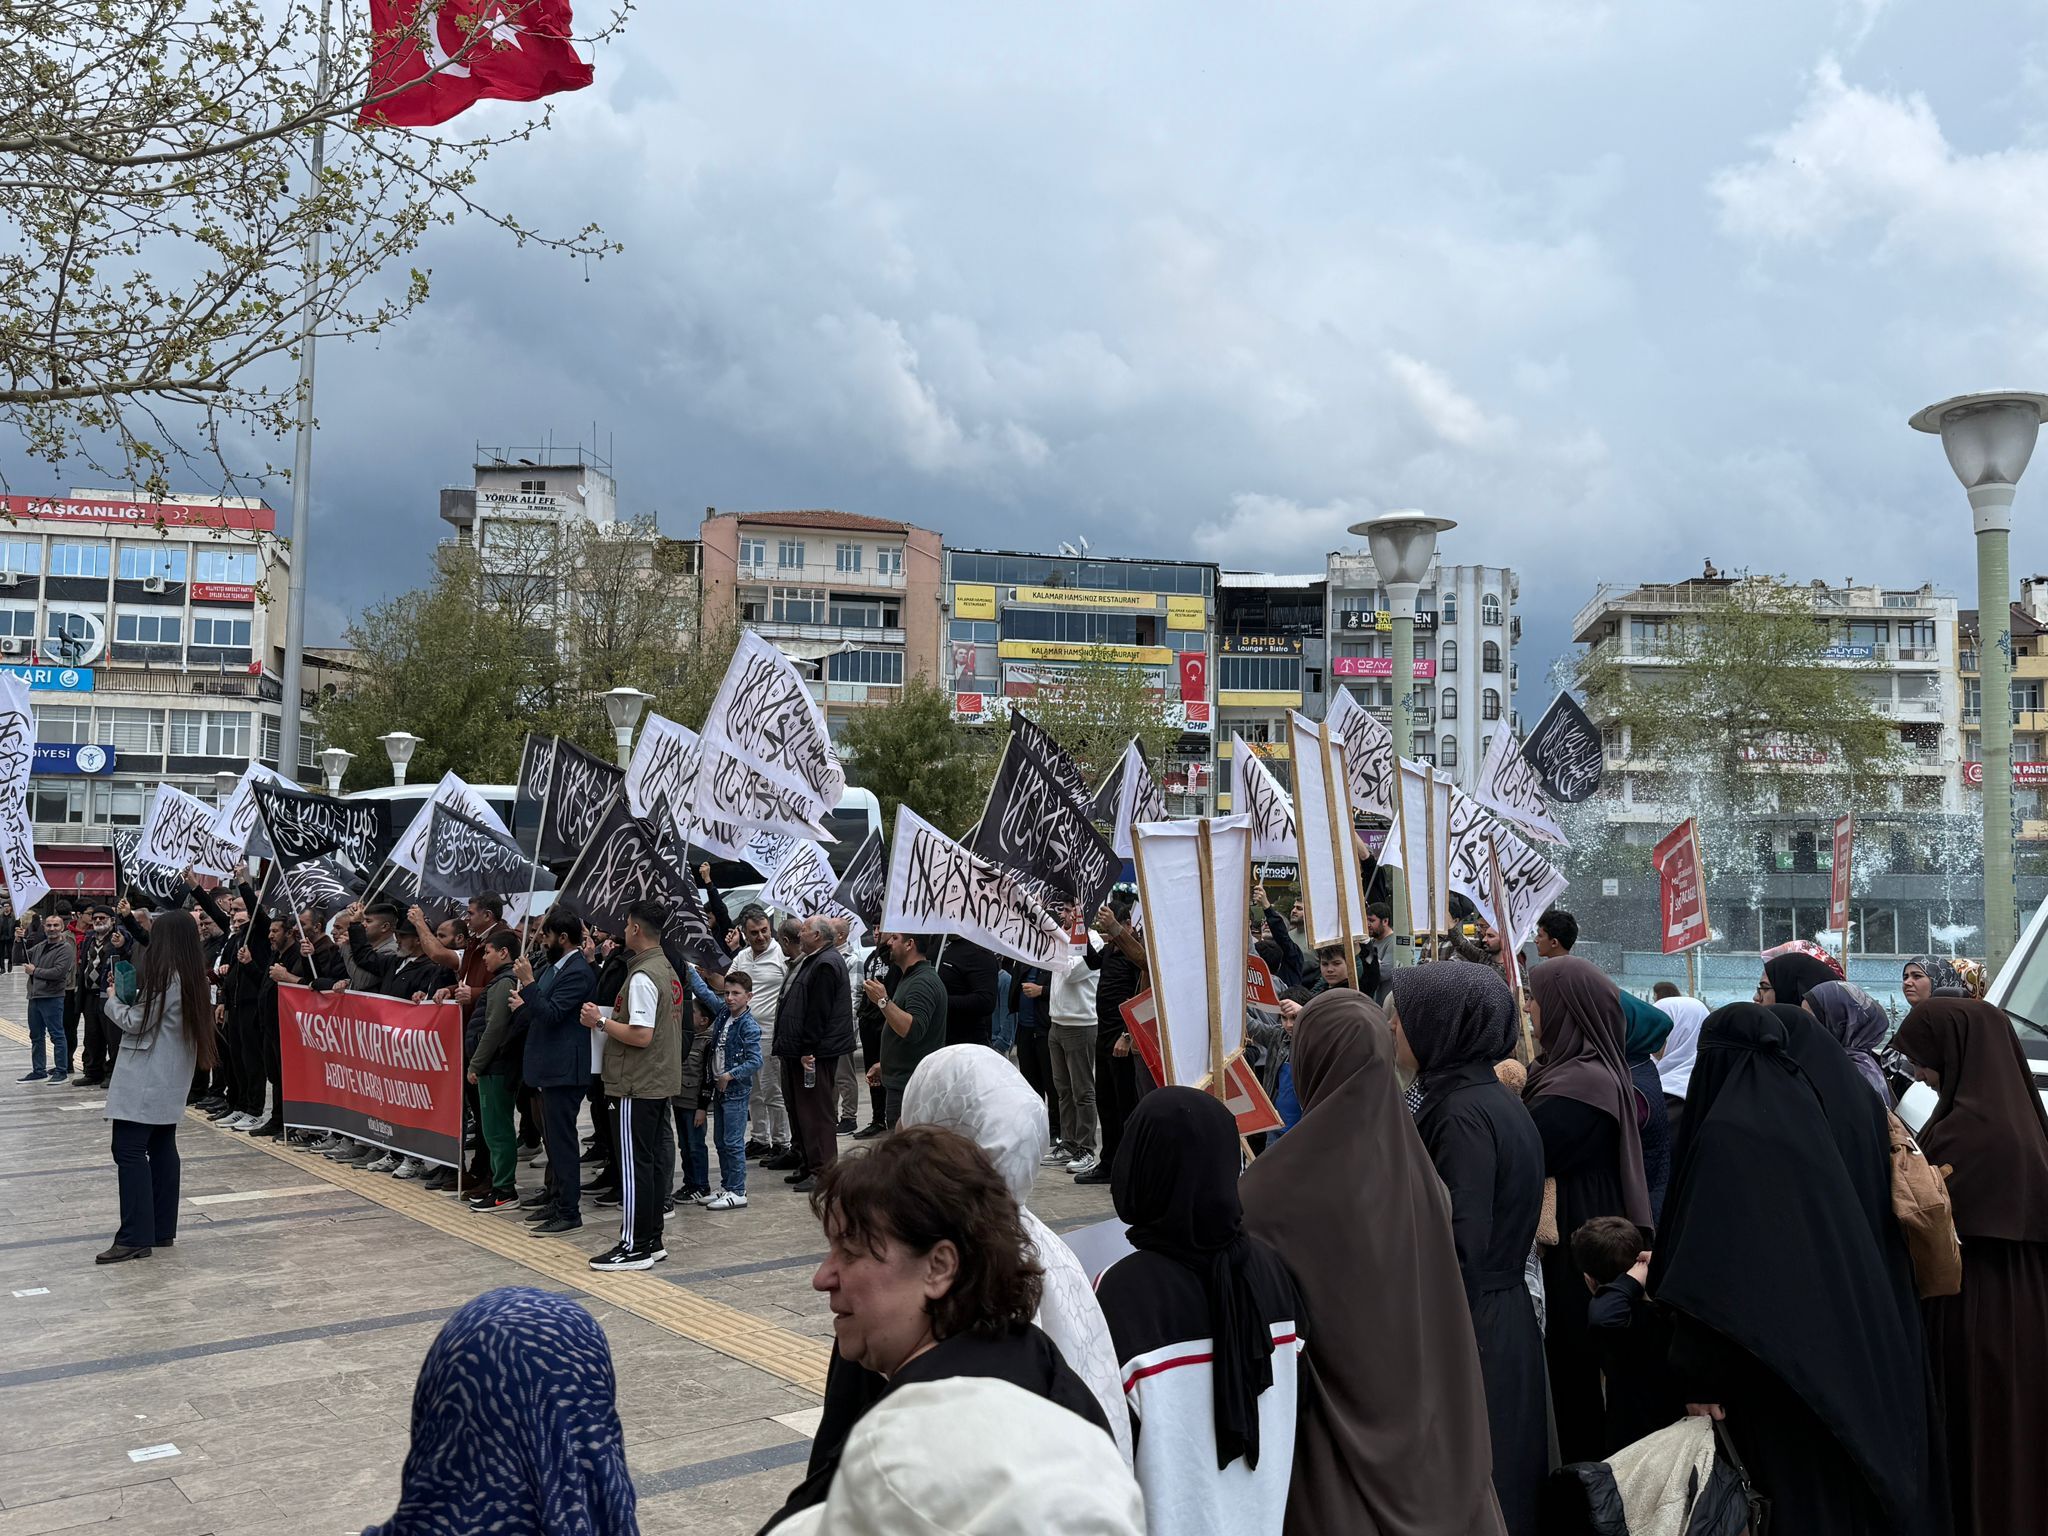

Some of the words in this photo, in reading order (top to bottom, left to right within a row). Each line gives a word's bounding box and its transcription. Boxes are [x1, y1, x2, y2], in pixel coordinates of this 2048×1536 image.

[485, 492, 518, 503] YÖRÜK
[520, 495, 536, 504] ALİ
[539, 497, 556, 505] EFE
[1032, 591, 1064, 600] KALAMAR
[1098, 595, 1140, 604] RESTAURANT
[1242, 636, 1285, 646] BAMBU
[1031, 647, 1063, 656] KALAMAR
[1237, 645, 1263, 653] Lounge
[1269, 645, 1289, 653] Bistro
[1187, 721, 1208, 731] CHP
[296, 1011, 355, 1058] AKSA'YI
[355, 1019, 450, 1072] KURTARIN!
[356, 1070, 385, 1106] KARŞI
[383, 1078, 434, 1111] DURUN!
